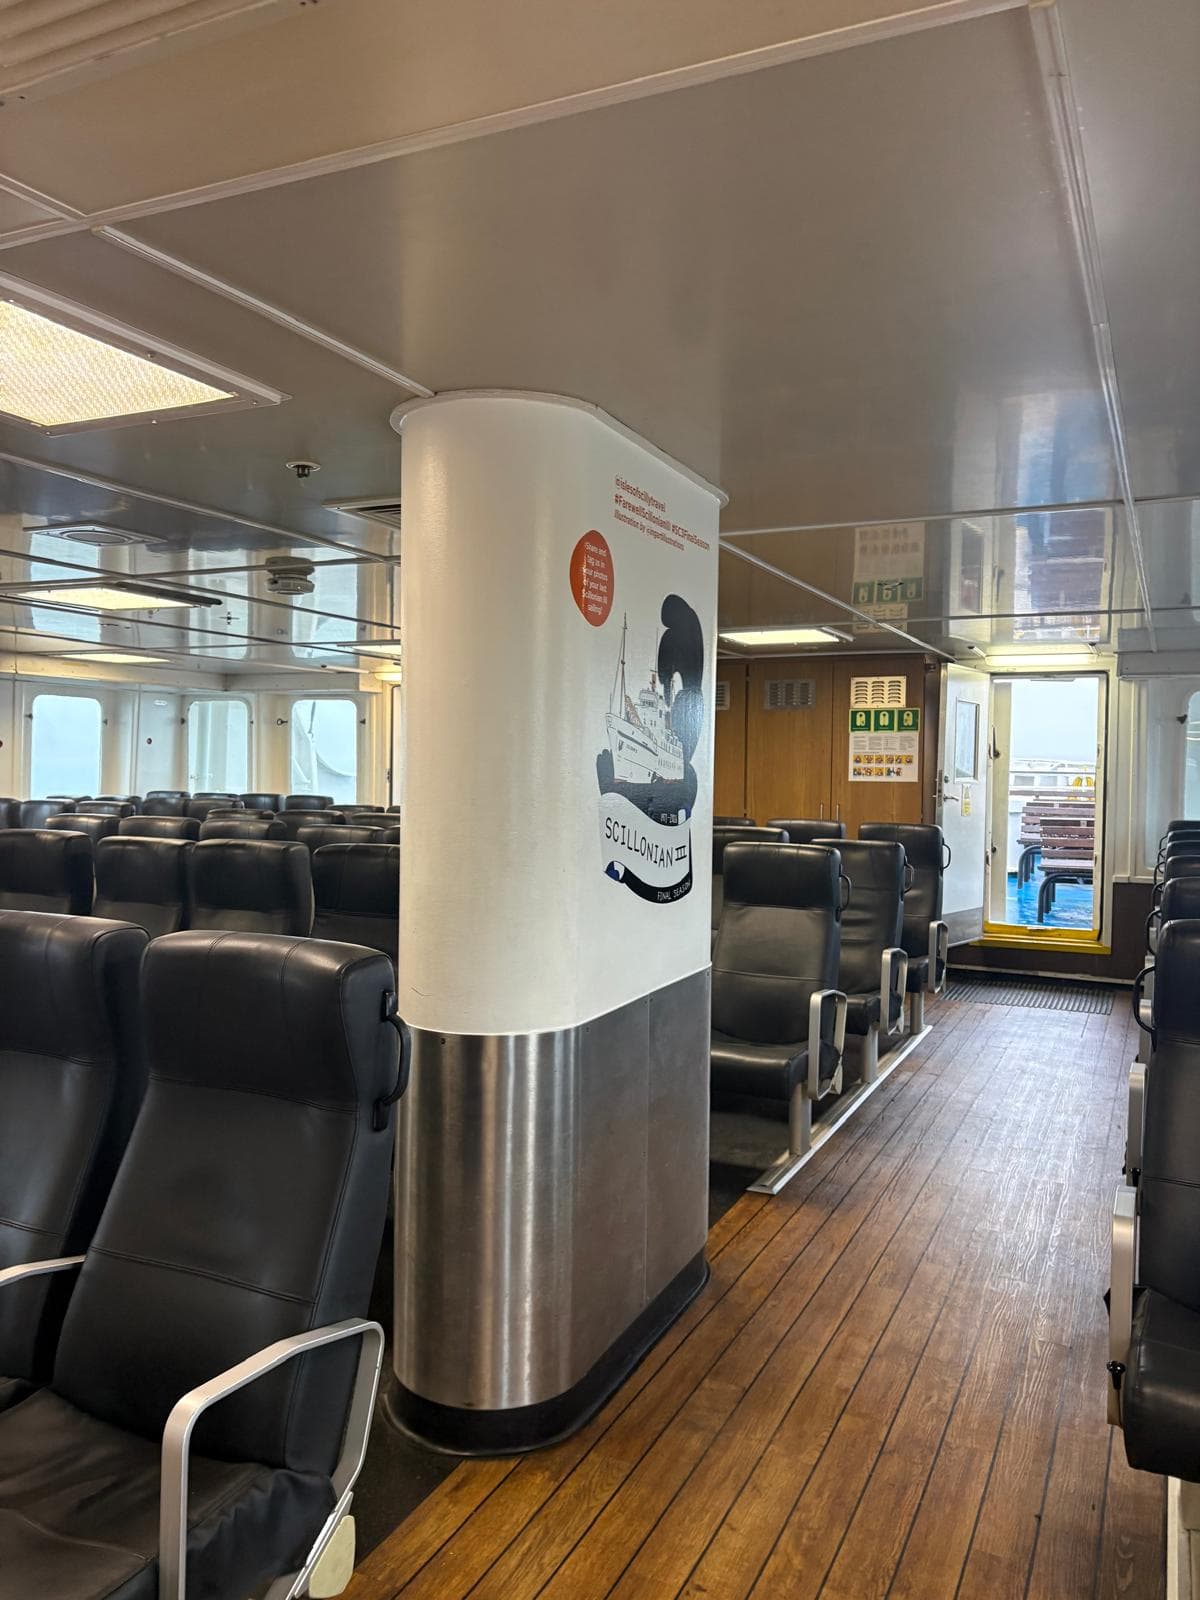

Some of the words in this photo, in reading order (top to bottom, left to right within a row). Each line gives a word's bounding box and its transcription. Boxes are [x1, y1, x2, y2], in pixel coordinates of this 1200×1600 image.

[586, 555, 595, 567] tag
[589, 581, 599, 590] your
[605, 816, 673, 869] SCILLONIAN
[674, 845, 688, 862] III
[657, 890, 672, 901] FINAL
[673, 881, 691, 898] SEASON
